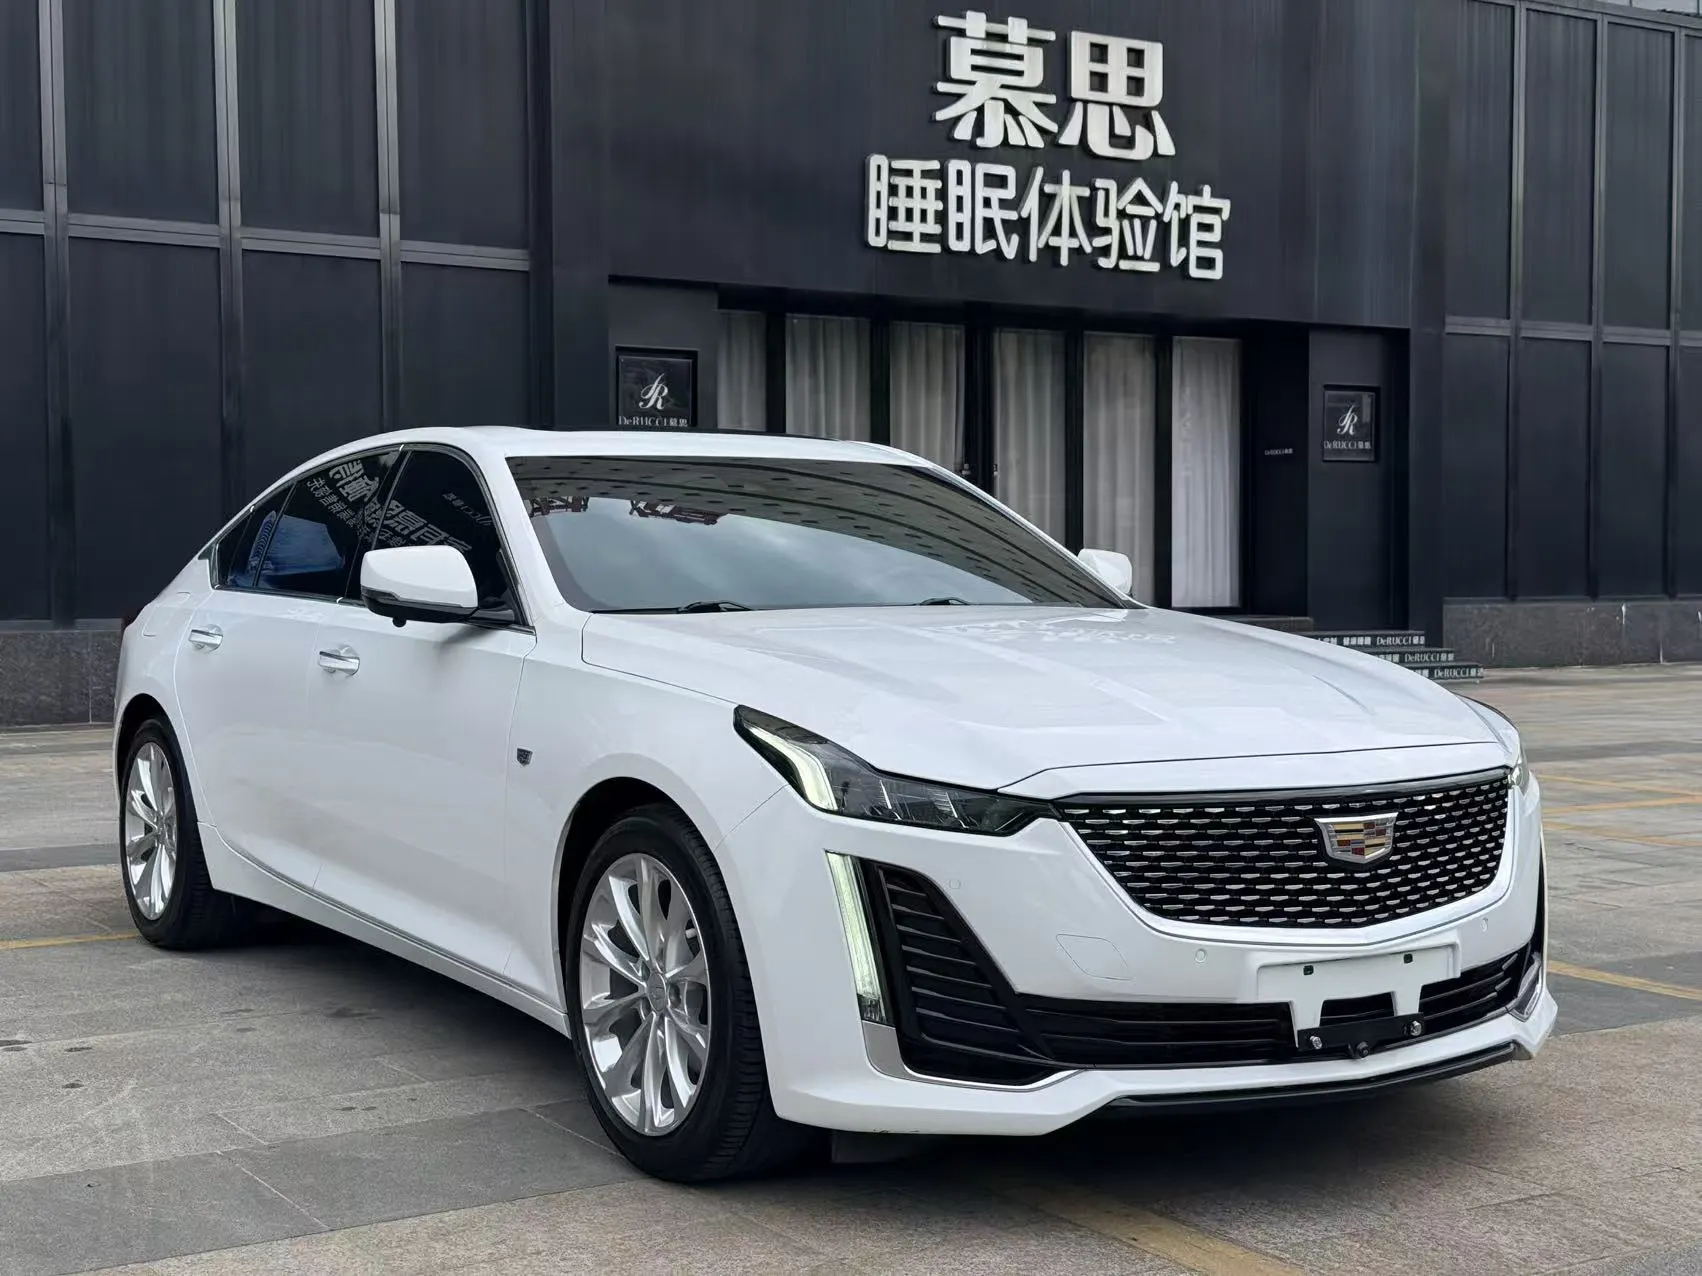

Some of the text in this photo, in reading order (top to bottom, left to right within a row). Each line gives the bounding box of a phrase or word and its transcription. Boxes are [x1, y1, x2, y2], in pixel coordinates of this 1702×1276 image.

[934, 10, 1177, 160] 慕思
[866, 153, 1231, 280] 睡眠体验馆
